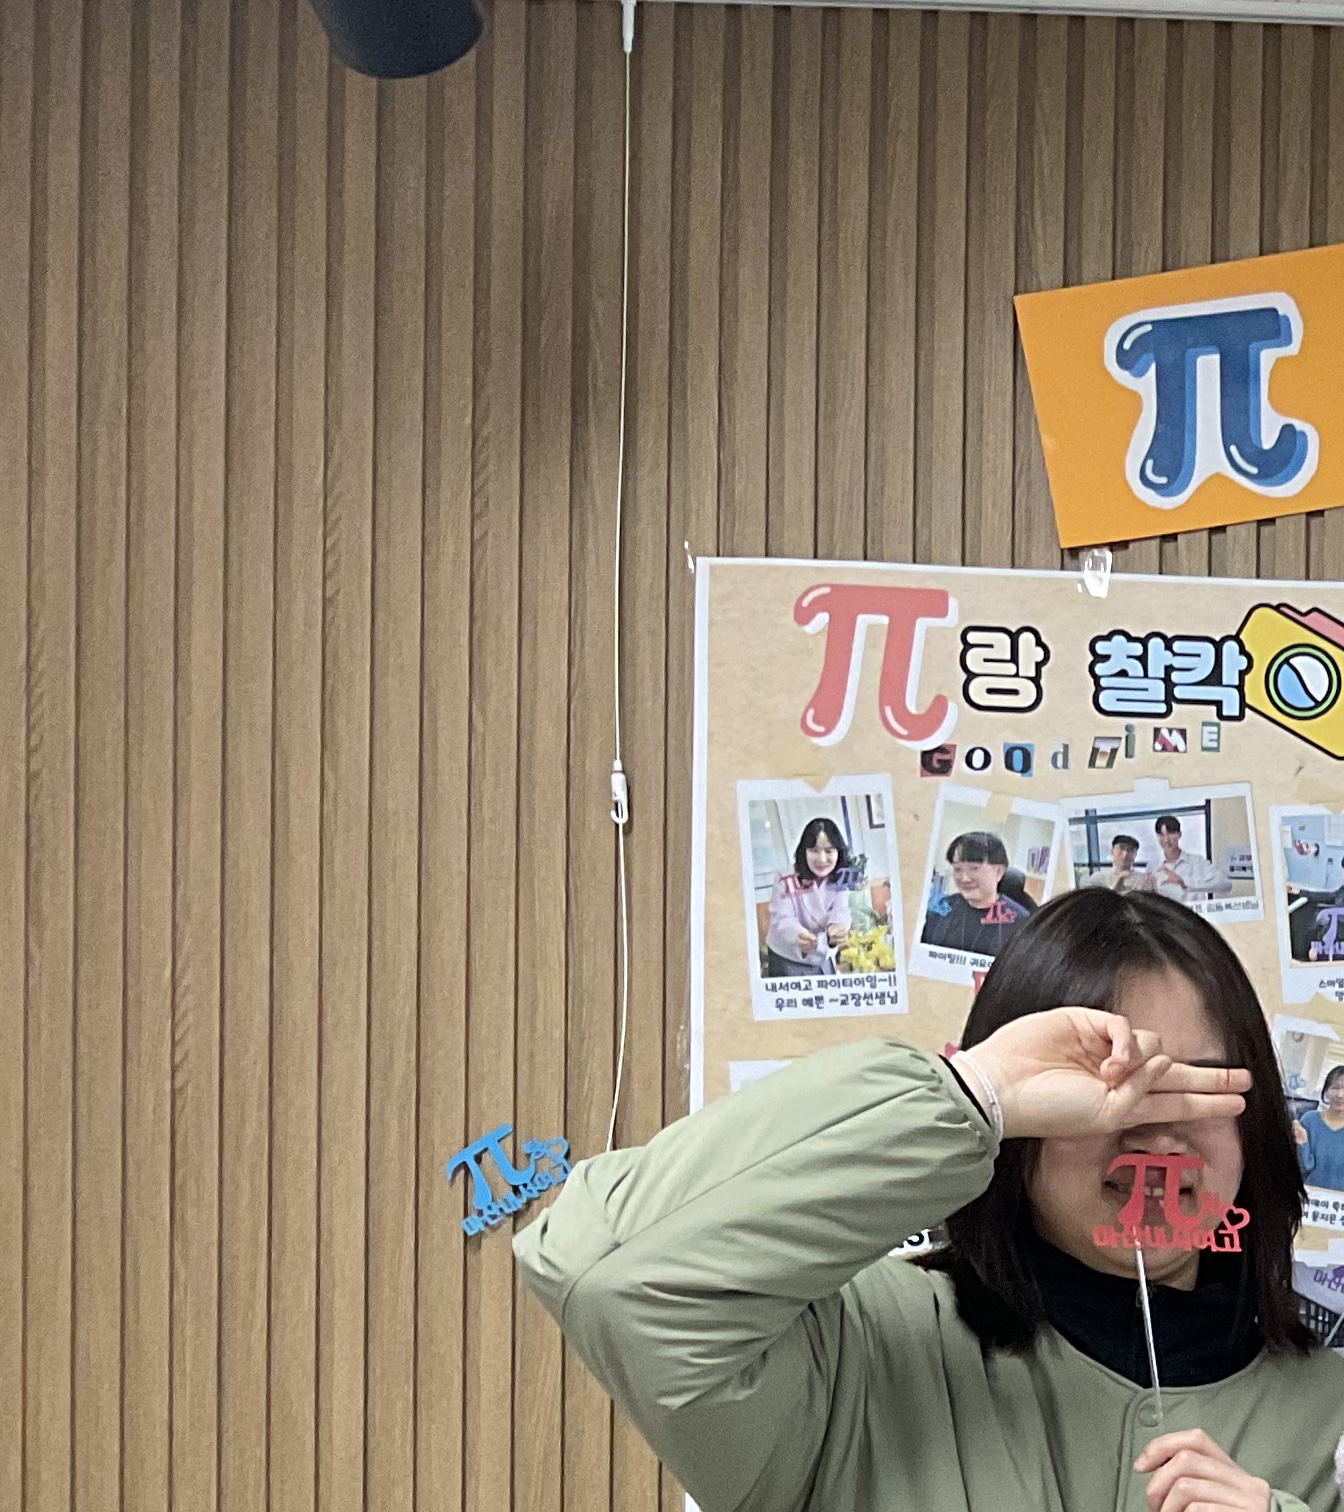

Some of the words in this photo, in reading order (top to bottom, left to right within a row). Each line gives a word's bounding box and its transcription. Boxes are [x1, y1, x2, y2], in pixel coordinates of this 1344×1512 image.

[1088, 628, 1252, 721] 찰칵
[764, 978, 813, 993] 내서여고
[774, 997, 798, 1012] 우리
